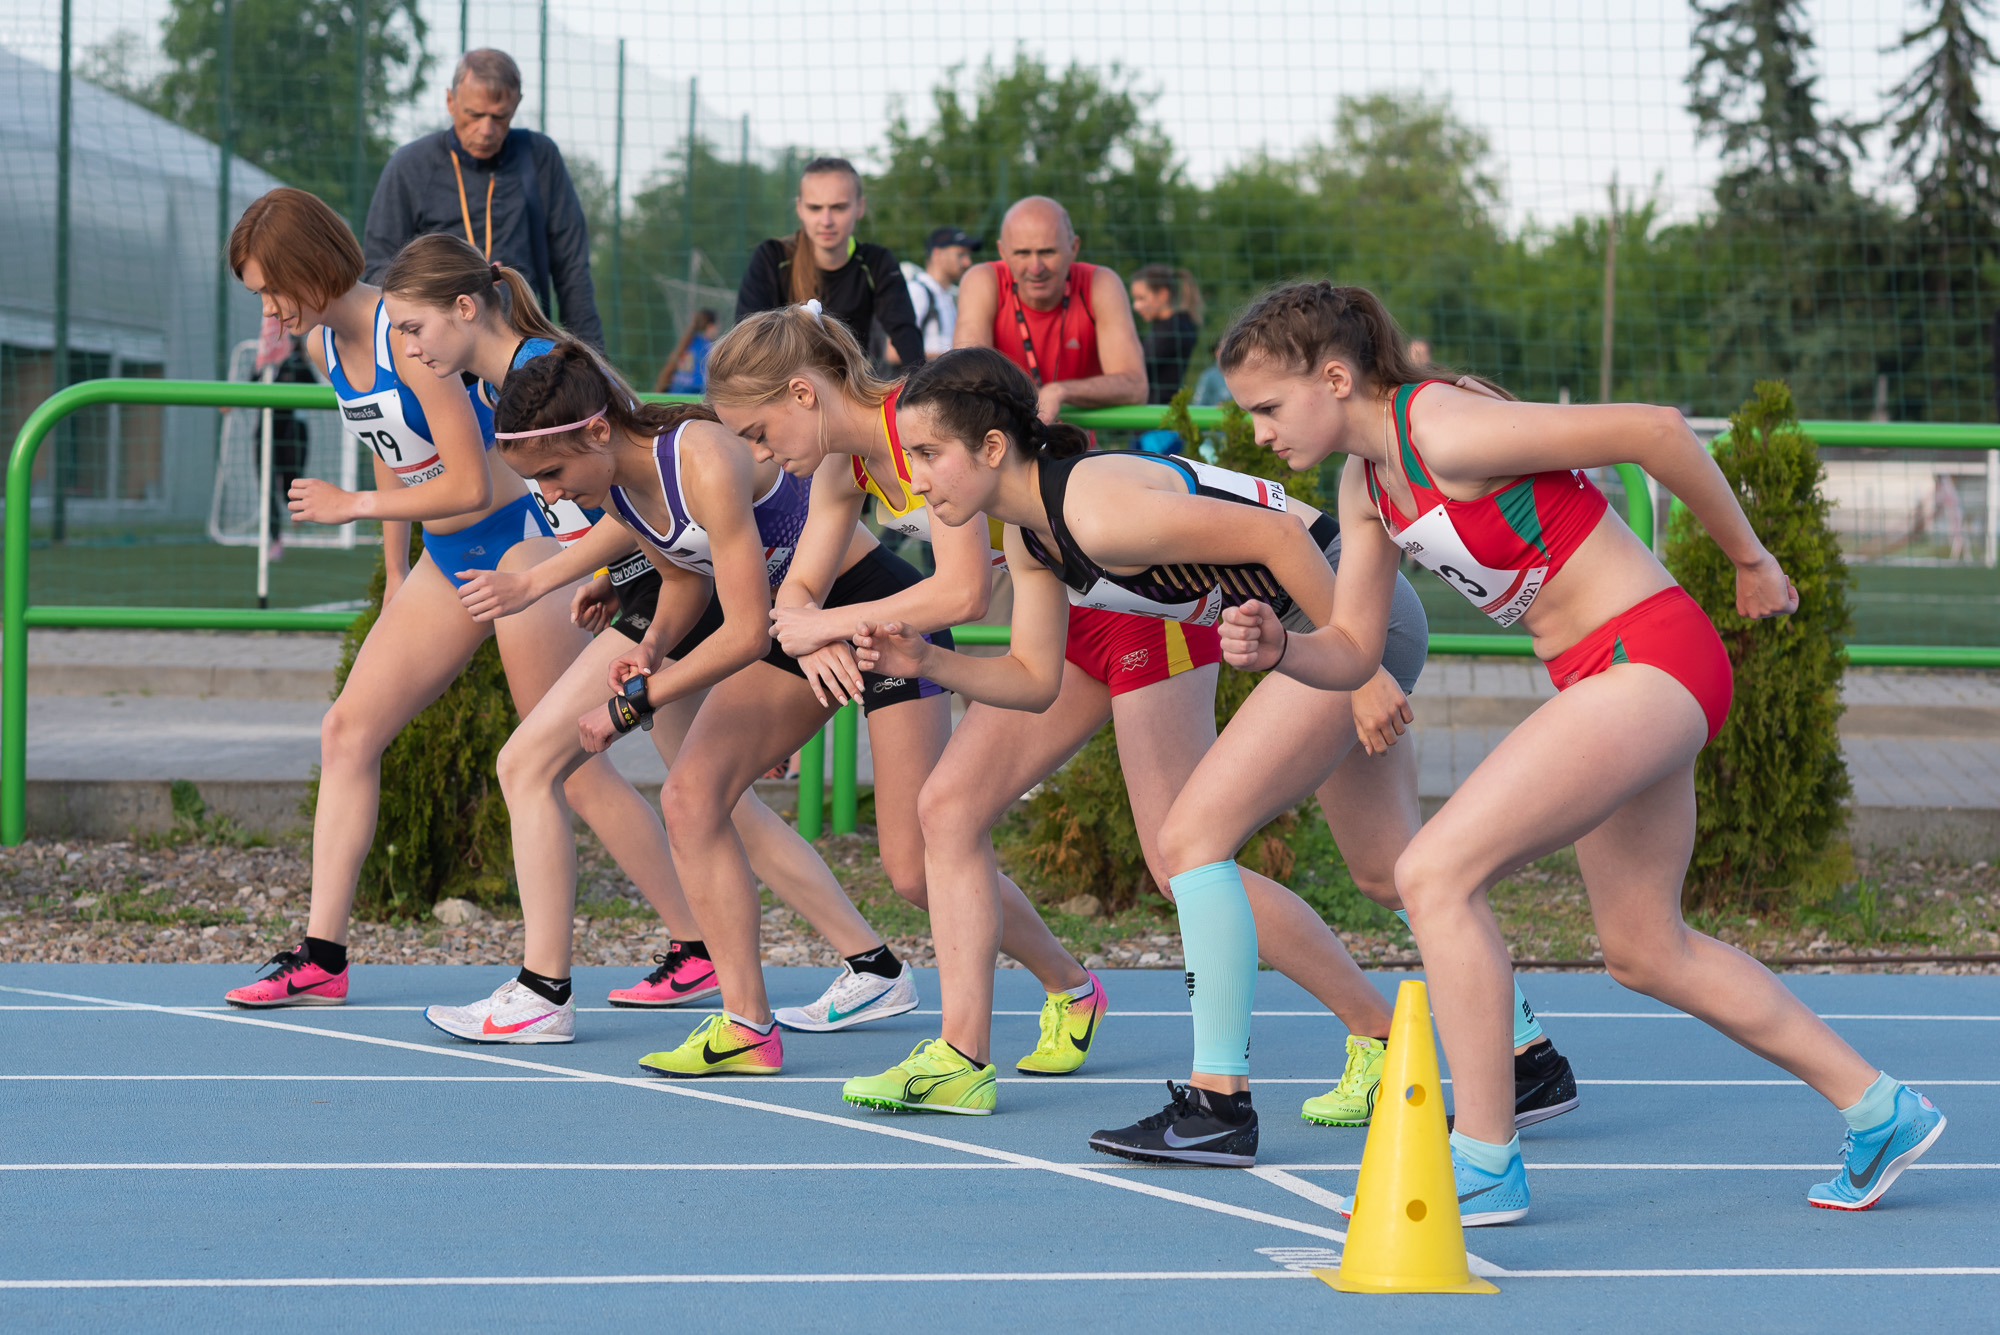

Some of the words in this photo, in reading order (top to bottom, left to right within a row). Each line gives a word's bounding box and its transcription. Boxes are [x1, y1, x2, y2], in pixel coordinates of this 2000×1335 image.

[358, 430, 403, 462] 79
[533, 492, 560, 529] 8
[611, 570, 624, 582] new
[1514, 582, 1540, 607] 2021
[1203, 599, 1220, 620] 2021
